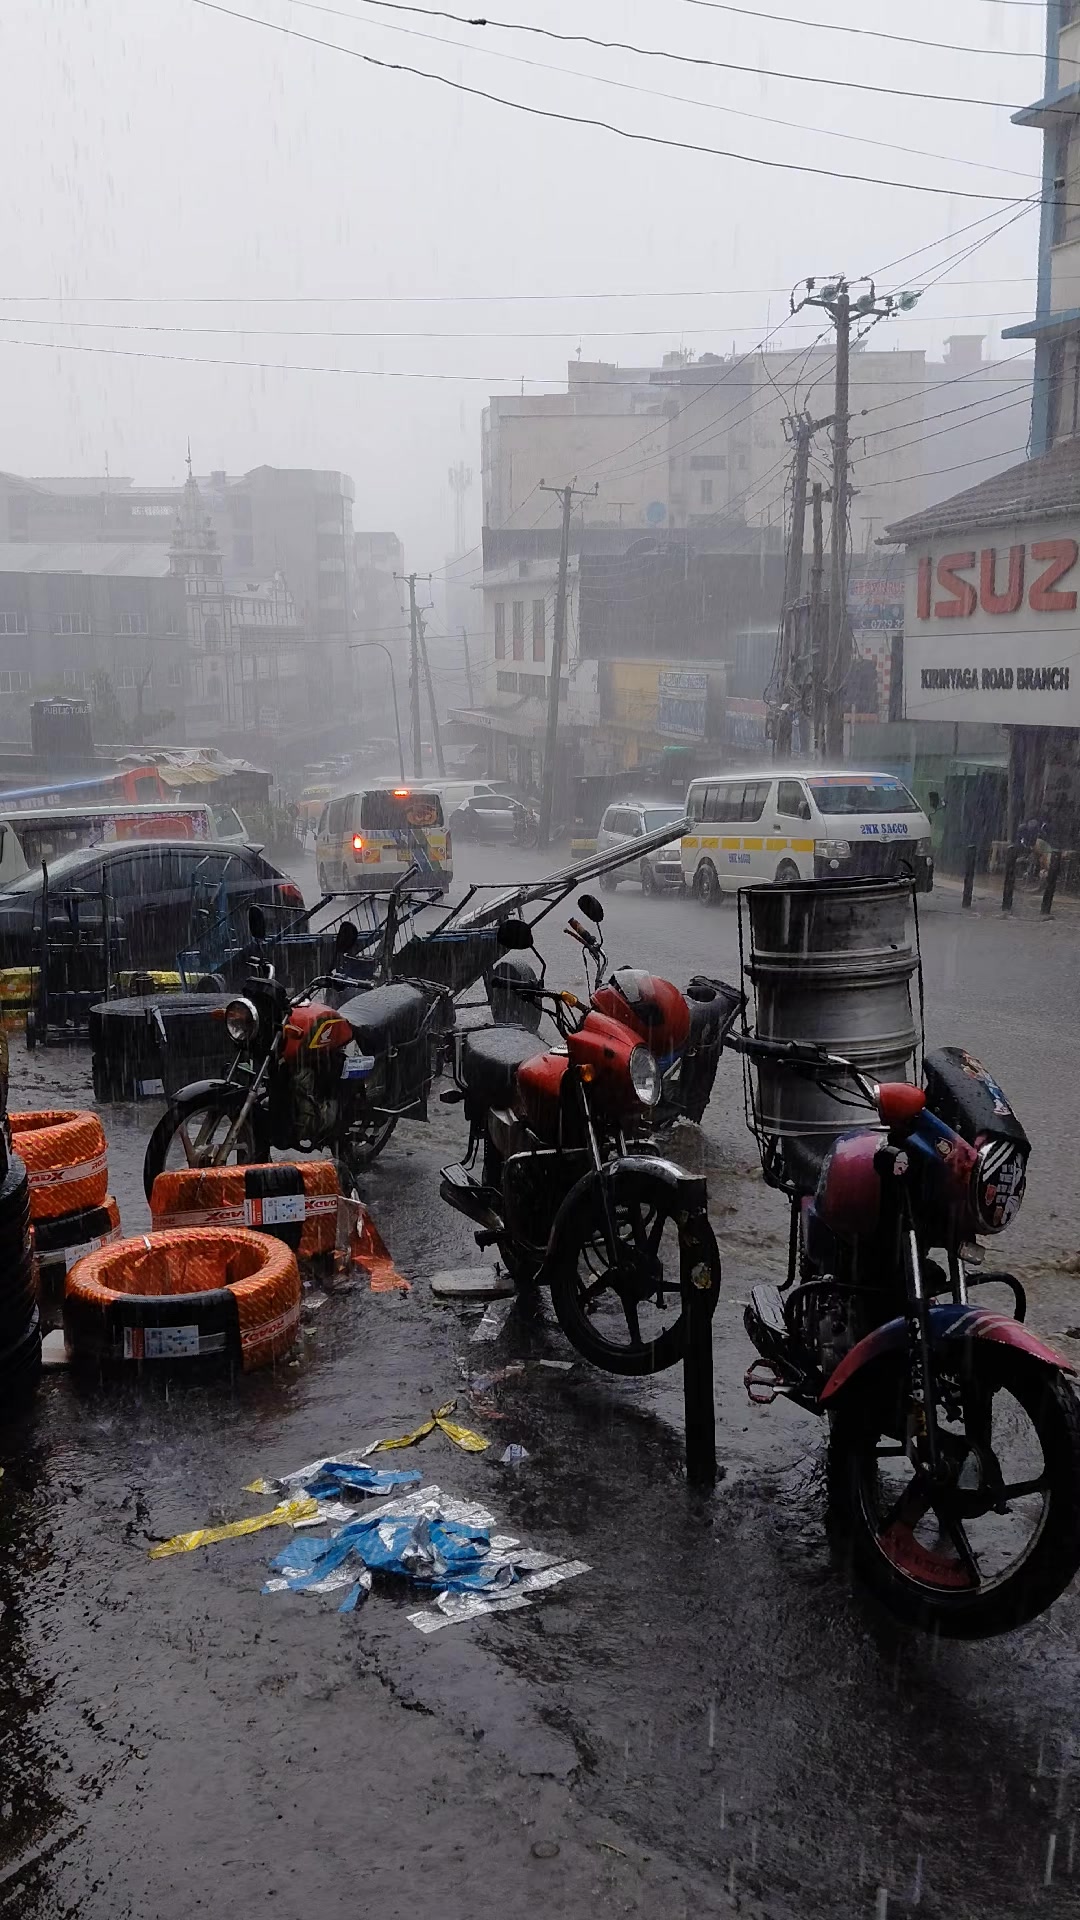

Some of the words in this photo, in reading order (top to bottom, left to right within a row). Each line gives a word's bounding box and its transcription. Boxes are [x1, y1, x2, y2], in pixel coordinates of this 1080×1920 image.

[920, 668, 978, 690] KIRINYAGA
[981, 668, 1014, 690] ROAD
[1016, 667, 1070, 690] BRANCH
[860, 824, 879, 834] 2NK
[881, 824, 908, 834] SACCO
